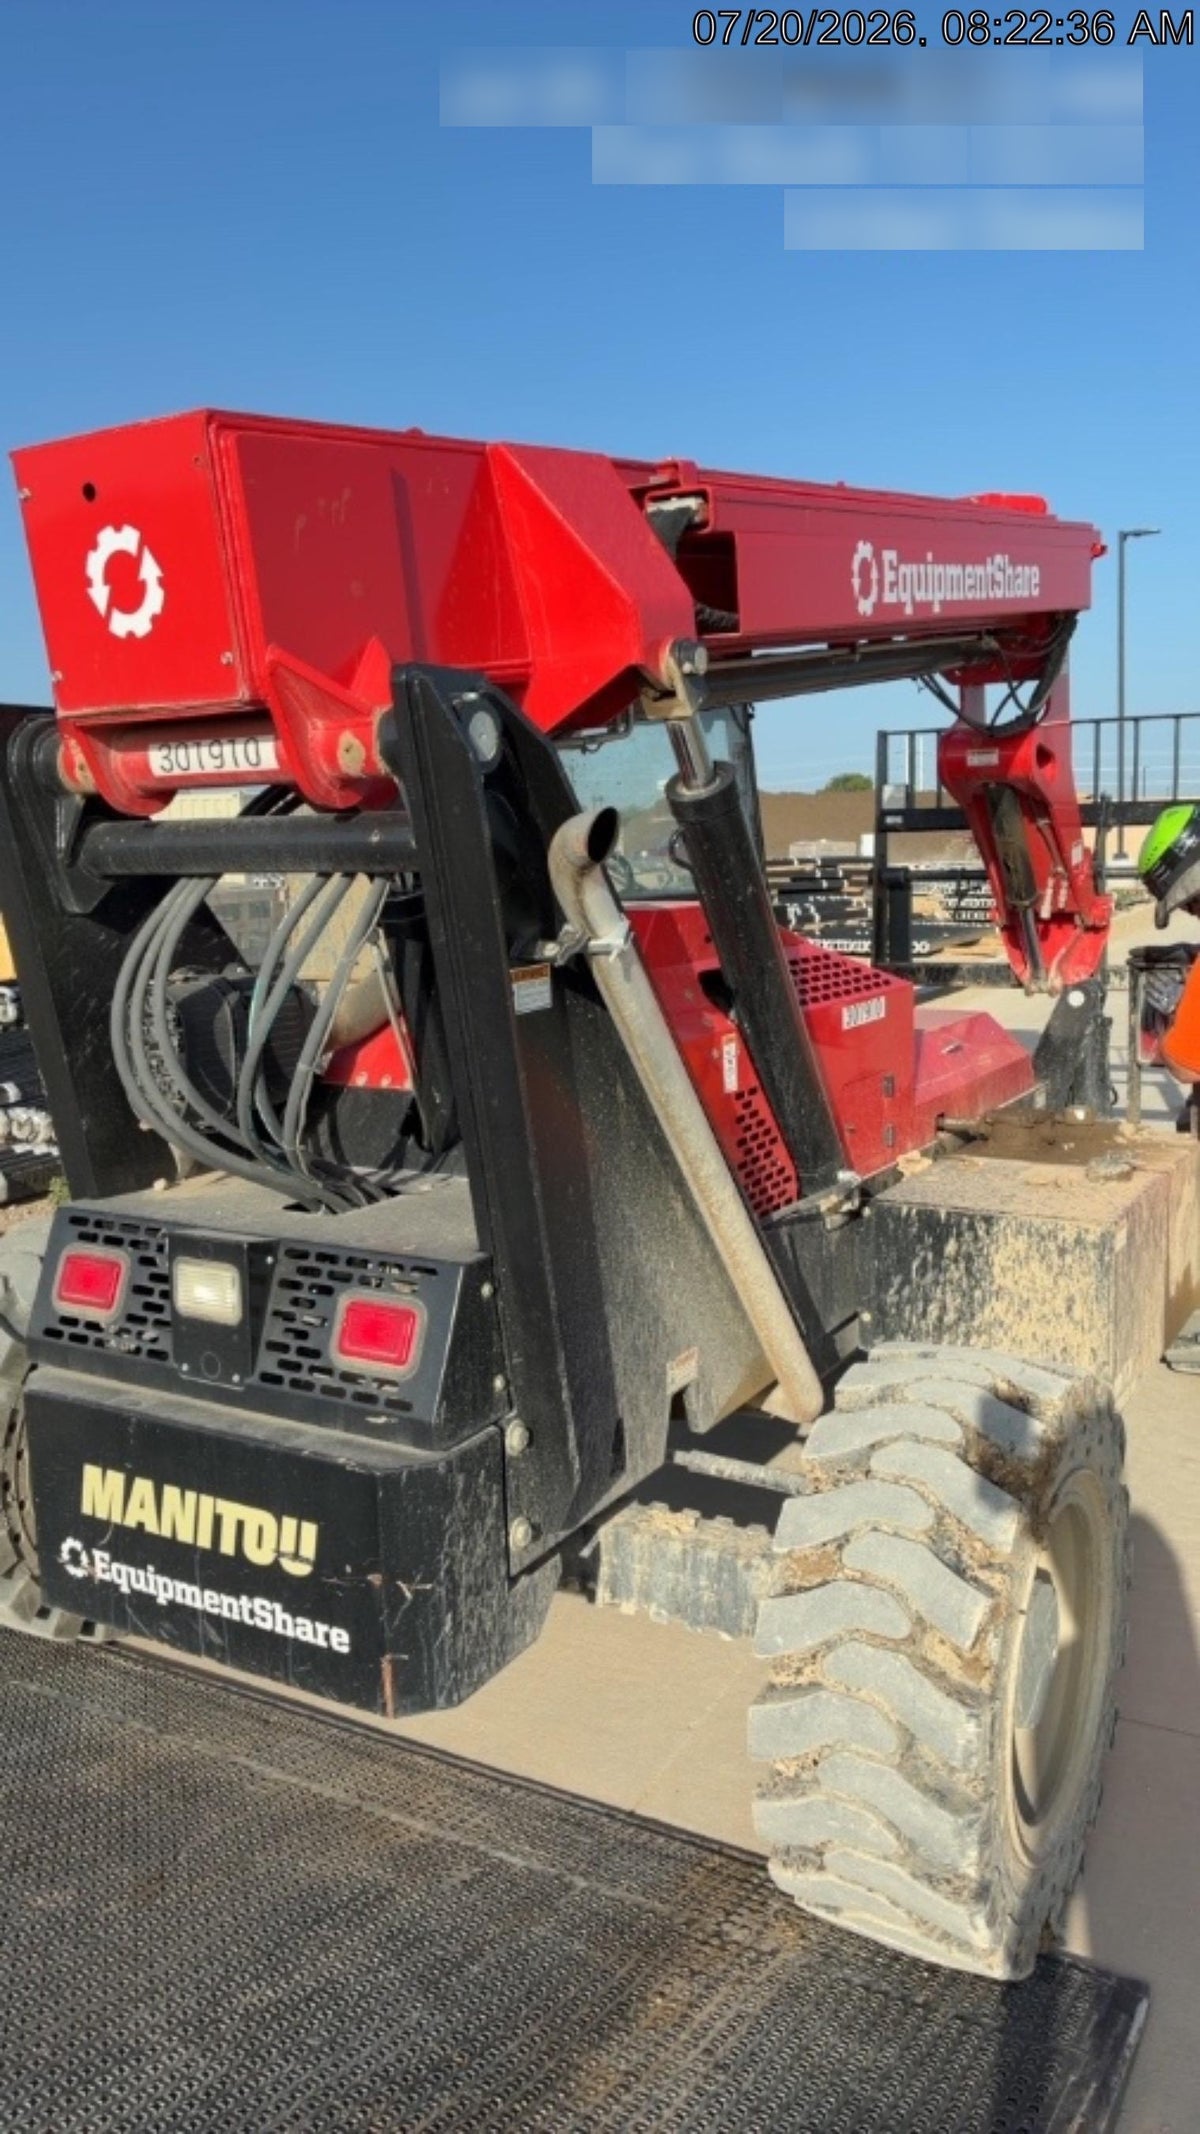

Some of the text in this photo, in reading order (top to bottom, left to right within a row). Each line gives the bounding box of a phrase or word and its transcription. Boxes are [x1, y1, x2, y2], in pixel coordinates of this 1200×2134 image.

[881, 549, 1041, 616] EquipmentShare
[158, 737, 262, 773] 301910
[80, 1463, 319, 1578] MANITOU
[91, 1547, 351, 1654] EquipmentShare
